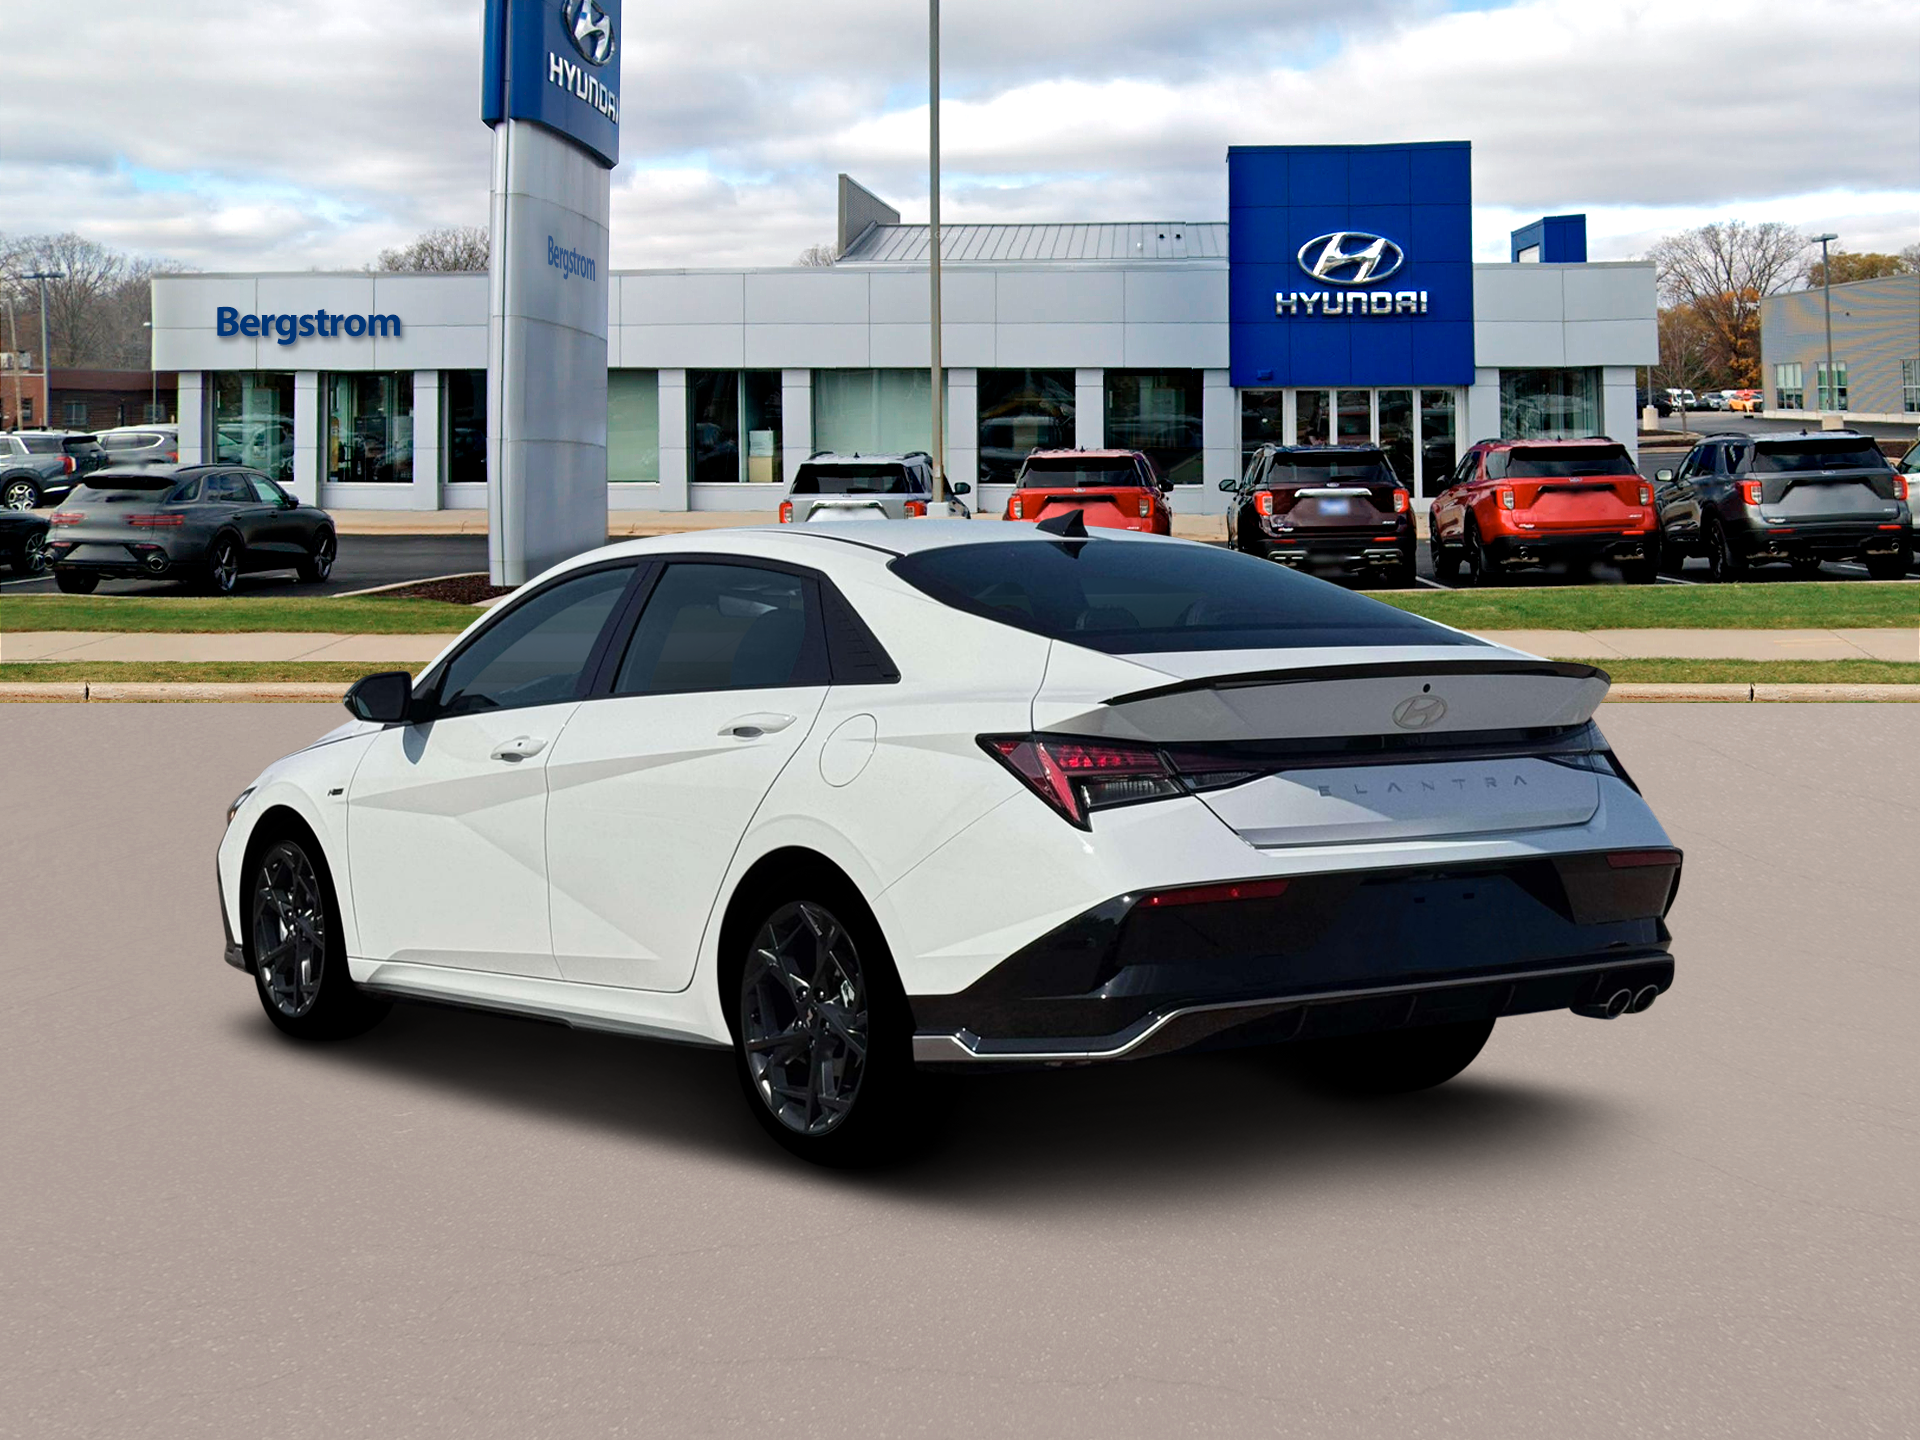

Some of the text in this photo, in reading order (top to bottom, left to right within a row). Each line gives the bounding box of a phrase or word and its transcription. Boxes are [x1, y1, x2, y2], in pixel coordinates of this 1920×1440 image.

[549, 51, 618, 124] HYUNDAI
[547, 235, 596, 282] Bergstrom
[1275, 290, 1428, 315] HYUNDAI
[216, 306, 402, 346] Bergstrom
[1318, 774, 1528, 797] ELANTRA
